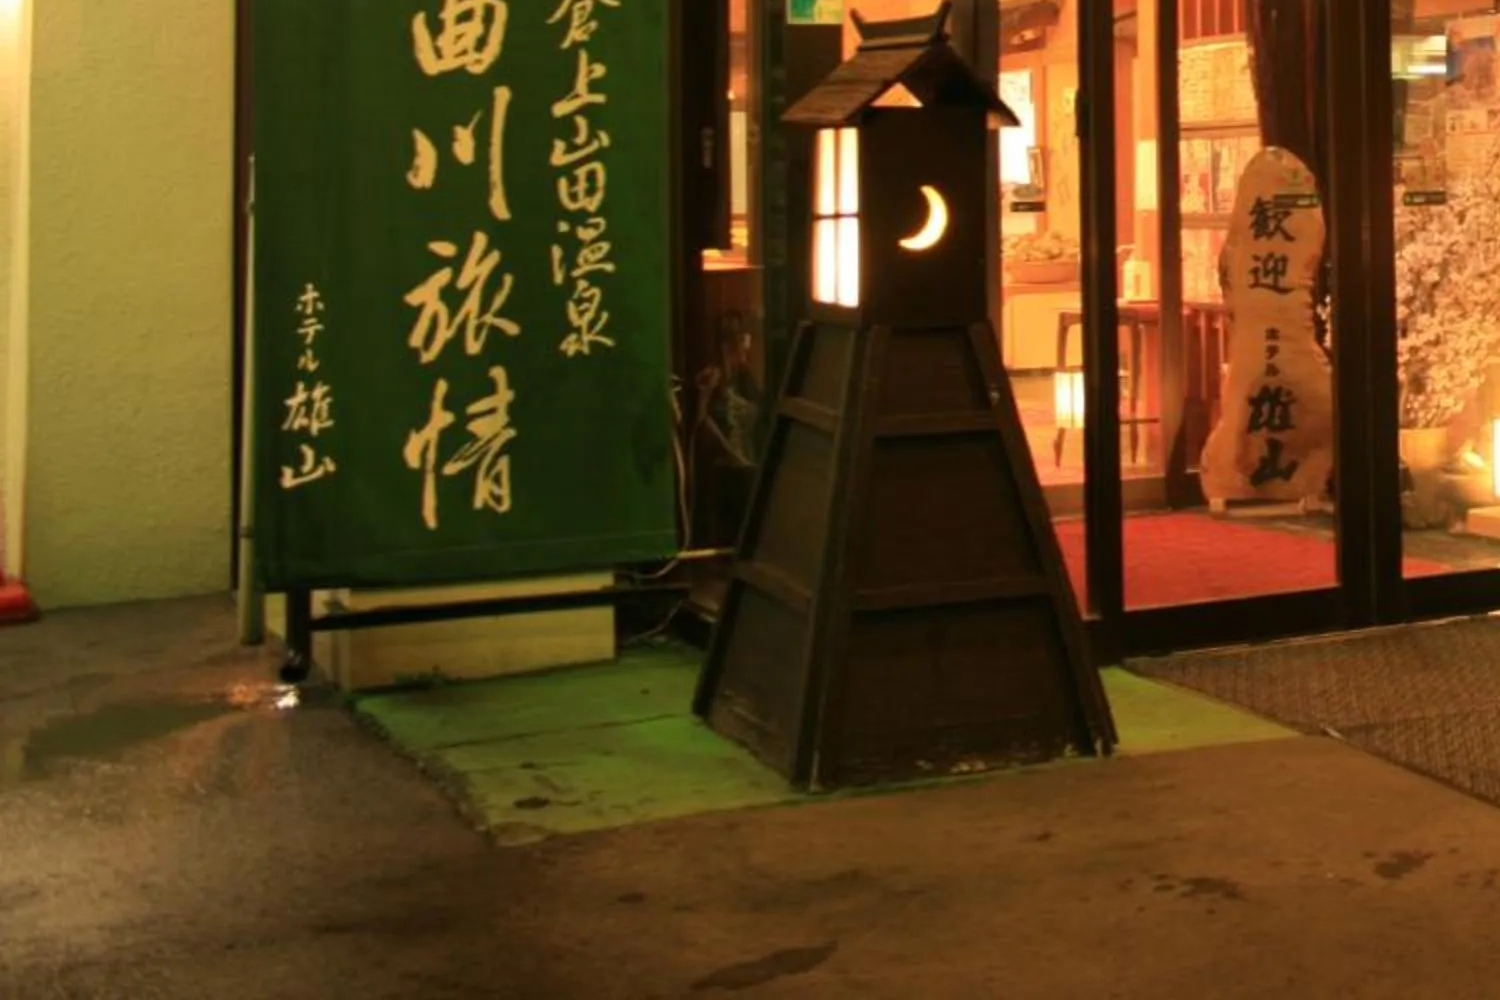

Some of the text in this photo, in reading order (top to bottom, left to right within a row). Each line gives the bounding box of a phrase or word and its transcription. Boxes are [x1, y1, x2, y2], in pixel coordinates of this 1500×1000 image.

[1248, 196, 1296, 296] 歓迎
[280, 283, 335, 489] ホテル雄山
